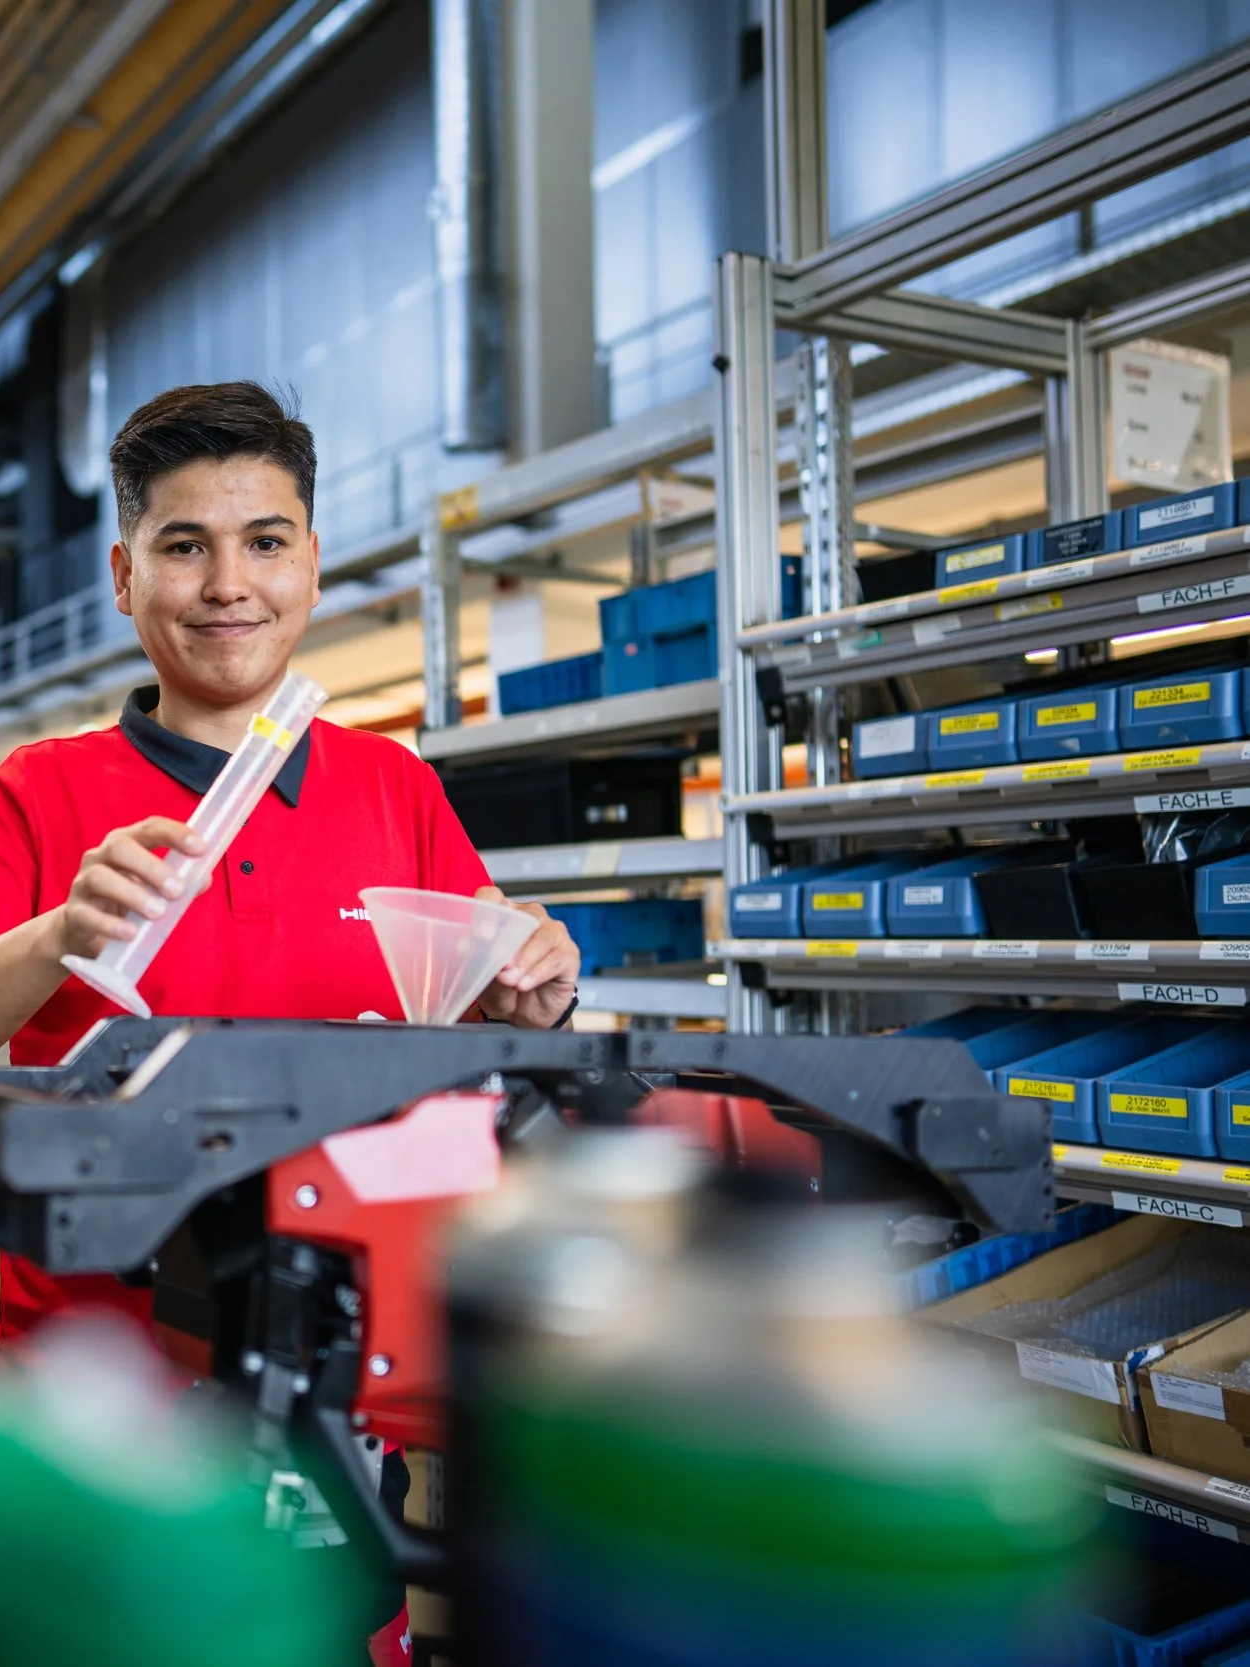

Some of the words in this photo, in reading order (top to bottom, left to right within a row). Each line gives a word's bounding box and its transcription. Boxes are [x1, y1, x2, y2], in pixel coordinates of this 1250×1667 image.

[1161, 579, 1235, 606] FACH-F
[1158, 790, 1234, 810] FACH-E
[1220, 943, 1250, 951] 20965
[1143, 985, 1219, 1003] FACH-D
[1127, 1096, 1167, 1107] 2172160
[1137, 1196, 1215, 1221] FACH-C
[1131, 1494, 1210, 1531] FACH-B
